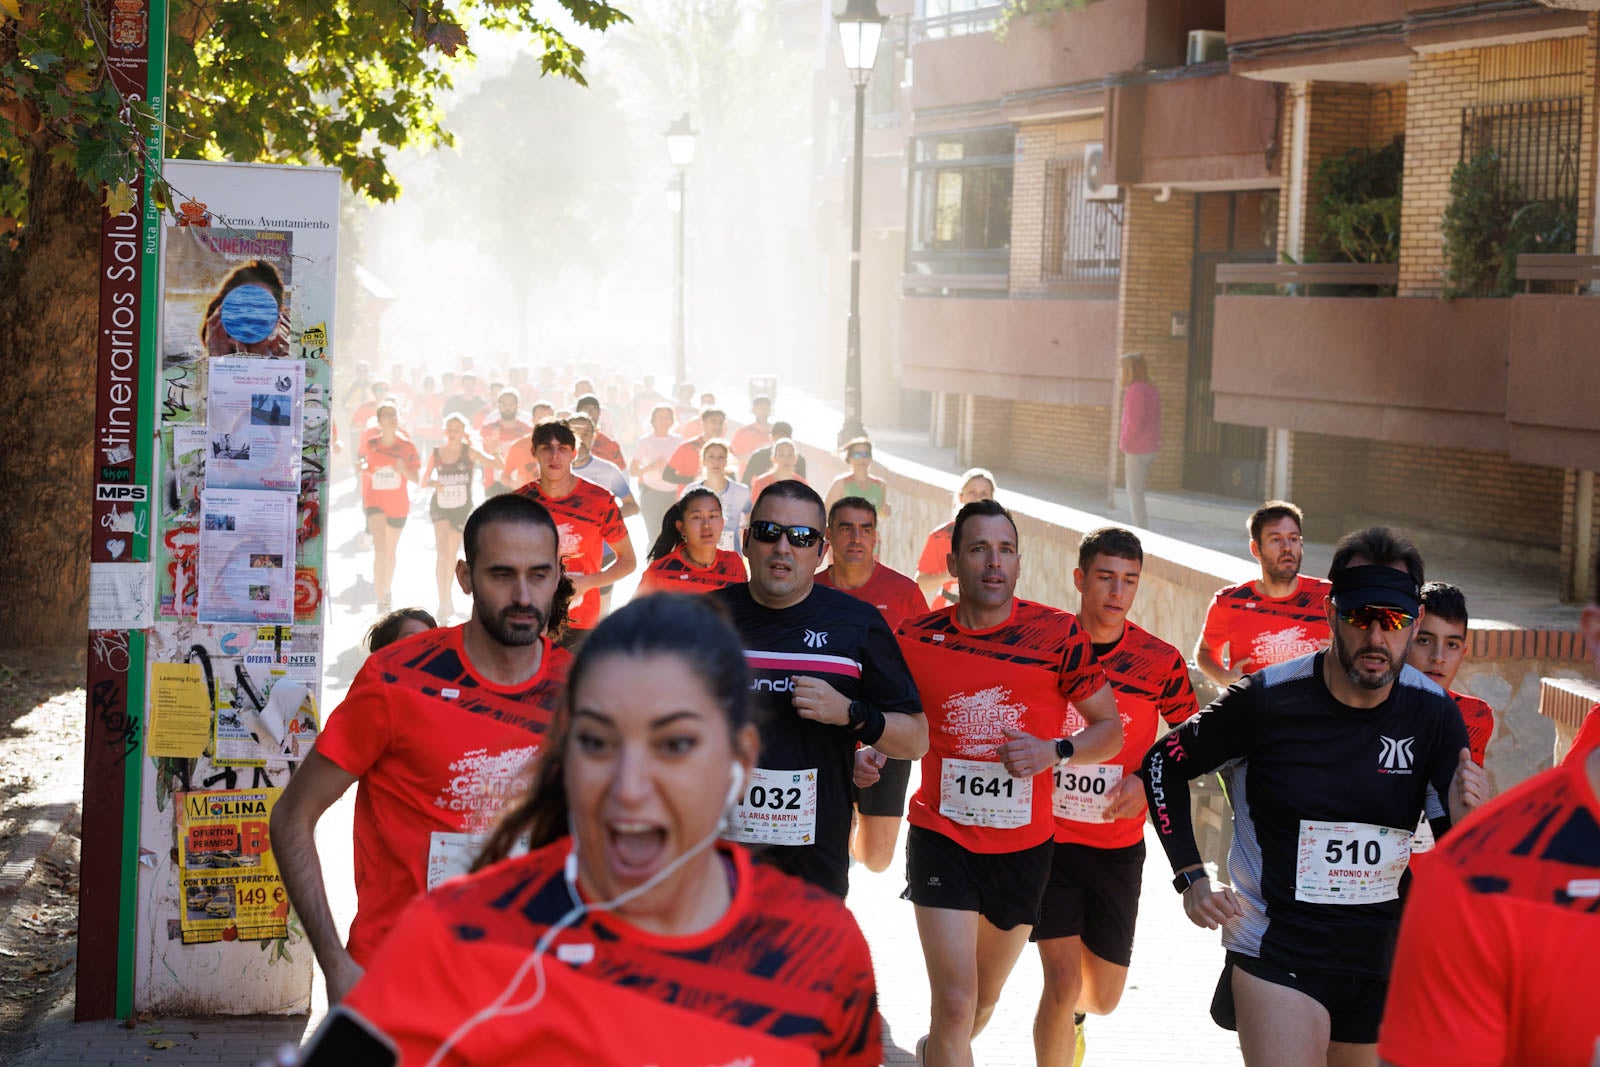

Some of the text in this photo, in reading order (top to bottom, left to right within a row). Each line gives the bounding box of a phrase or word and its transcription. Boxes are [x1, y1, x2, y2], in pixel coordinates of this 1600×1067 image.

[150, 96, 160, 131] Bcha
[149, 137, 158, 150] la
[260, 216, 330, 229] Ayuntamiento
[145, 228, 157, 254] Ruta
[101, 292, 135, 453] tinerarios
[99, 486, 145, 499] MPS
[1255, 641, 1314, 656] carrera
[246, 655, 272, 664] OFERTA
[159, 675, 185, 683] Learning
[946, 707, 1019, 724] carrera
[216, 759, 258, 767] Mejoramos
[955, 775, 1013, 798] 1641
[1053, 770, 1106, 795] 1300
[1064, 793, 1079, 801] JUAN
[190, 796, 267, 816] MOLINA
[748, 812, 770, 821] ARIAS
[771, 813, 798, 822] MARTÍN
[193, 839, 234, 849] PERMISO
[241, 821, 271, 855] B
[1325, 839, 1381, 866] 510
[183, 879, 199, 887] CON
[211, 876, 239, 885] CLASES
[241, 874, 282, 884] PRÁCTICA
[1328, 869, 1362, 878] ANTONIO
[237, 887, 285, 905] 149 €
